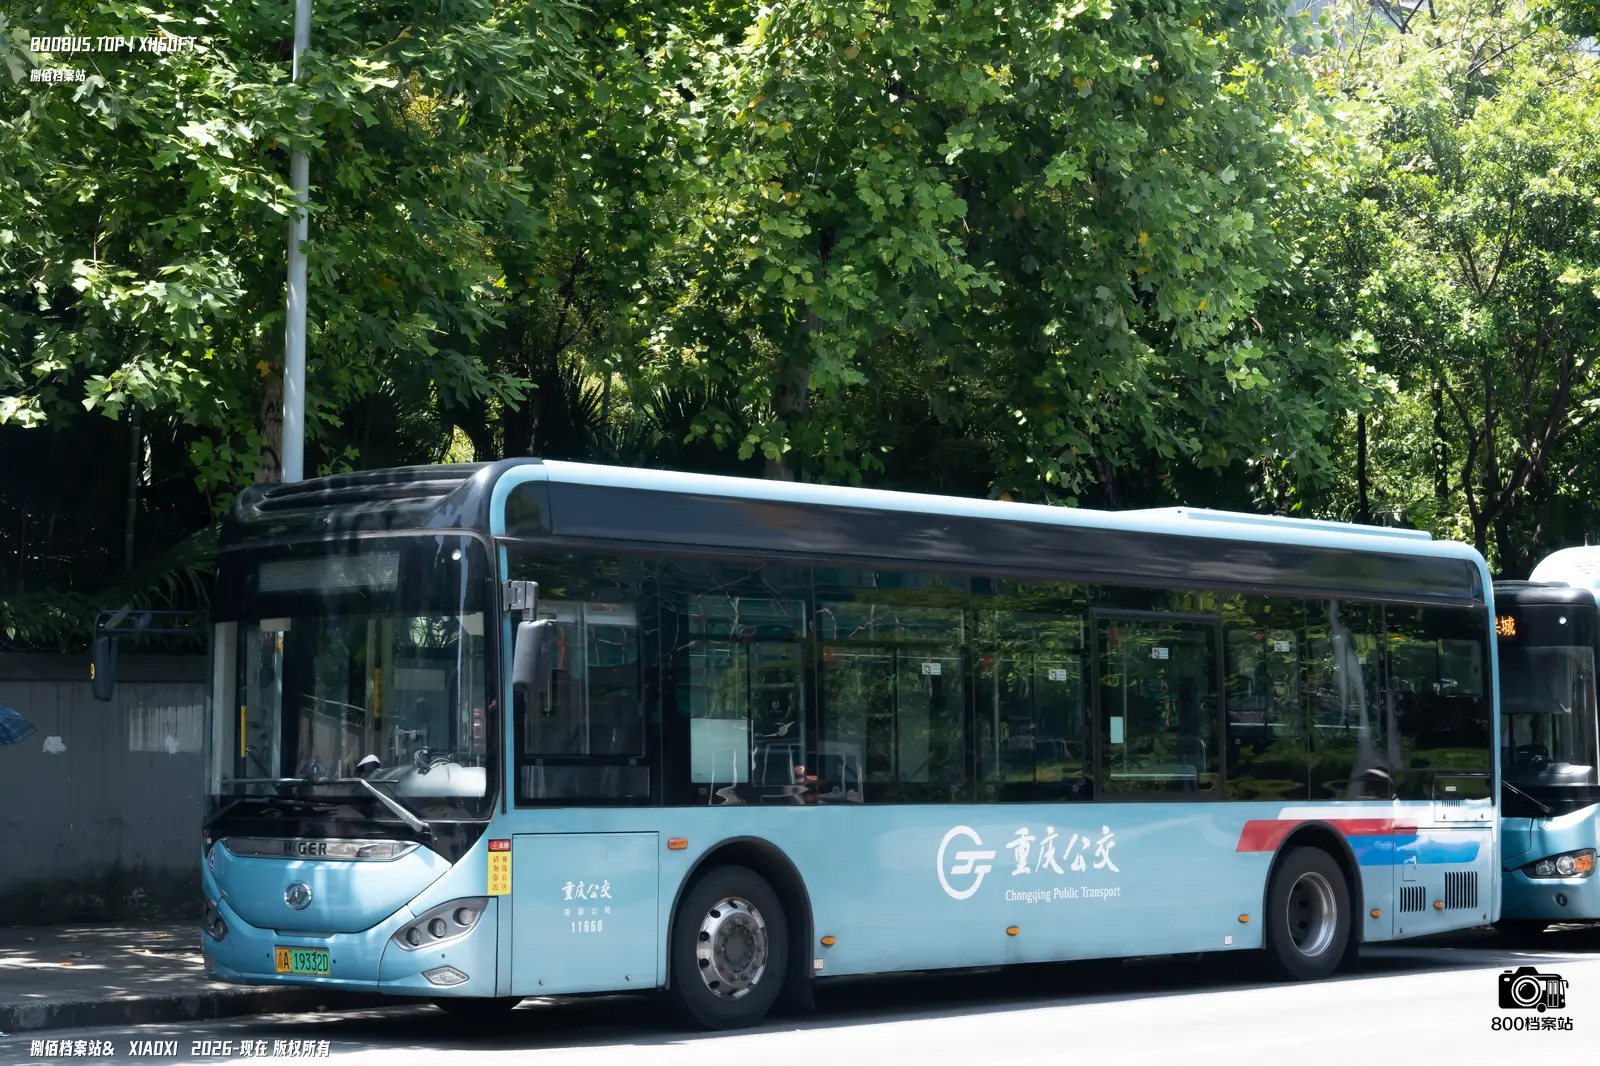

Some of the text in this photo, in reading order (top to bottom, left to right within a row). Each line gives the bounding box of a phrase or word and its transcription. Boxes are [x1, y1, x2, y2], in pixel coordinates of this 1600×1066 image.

[283, 841, 327, 856] HIGER
[1005, 825, 1120, 876] 重庆公交
[561, 880, 613, 901] 重庆公交
[1005, 885, 1121, 904] Chongqing Public Transport
[571, 919, 603, 933] 11660
